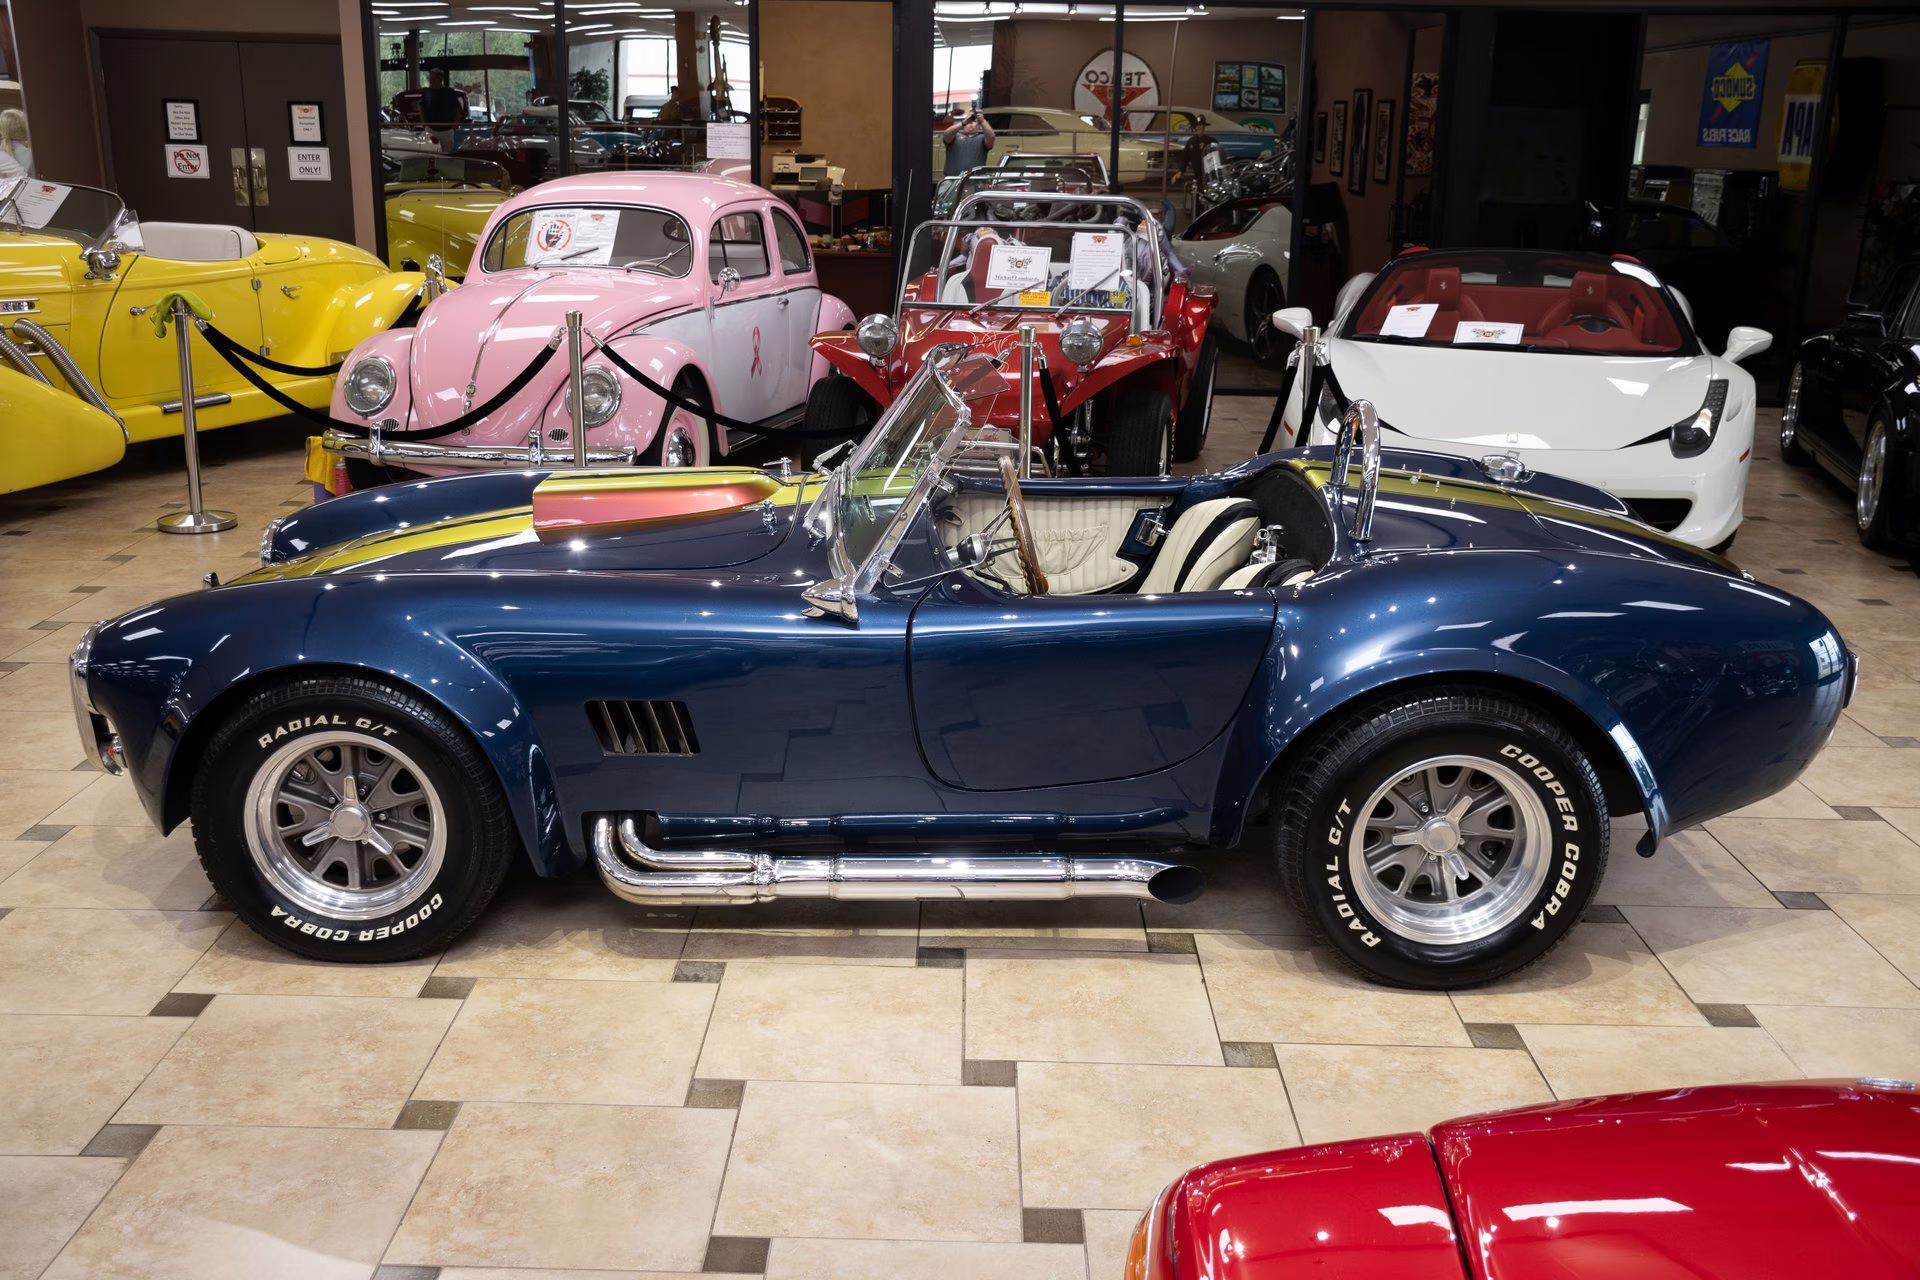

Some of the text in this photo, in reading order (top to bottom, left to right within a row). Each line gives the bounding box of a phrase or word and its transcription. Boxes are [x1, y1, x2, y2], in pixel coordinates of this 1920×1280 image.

[178, 162, 199, 170] Enter
[299, 166, 321, 174] ONLY!
[258, 714, 398, 749] RADIAL G/T
[1500, 744, 1580, 931] COOPER COBRA
[1326, 797, 1382, 948] RADIAL G/T
[270, 892, 443, 942] COOPER COBRA
